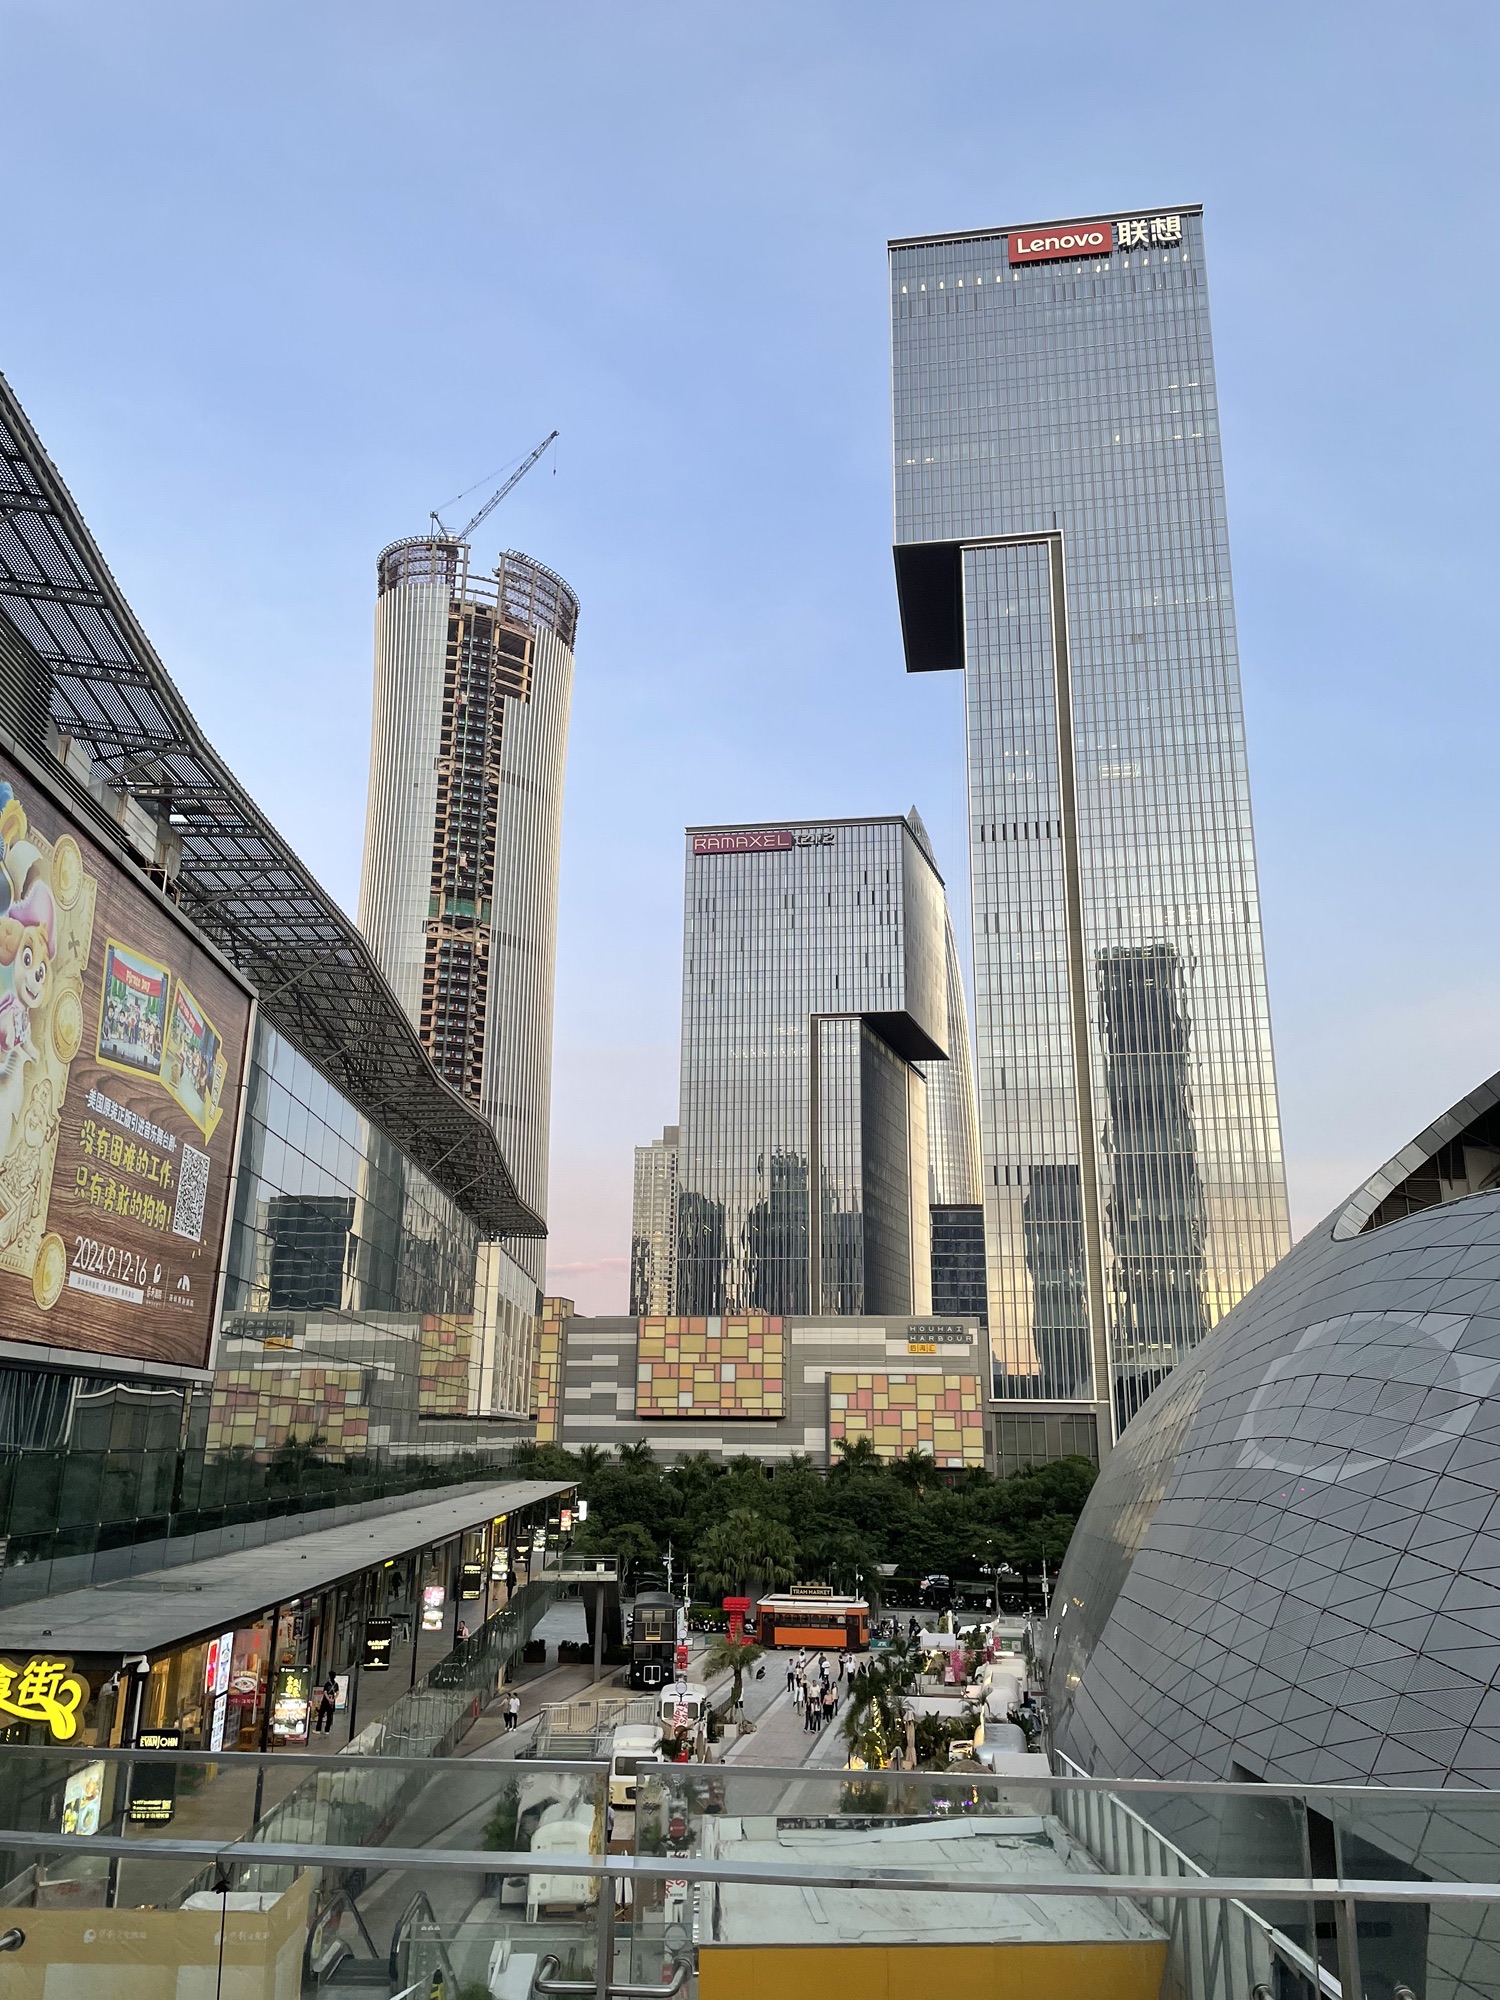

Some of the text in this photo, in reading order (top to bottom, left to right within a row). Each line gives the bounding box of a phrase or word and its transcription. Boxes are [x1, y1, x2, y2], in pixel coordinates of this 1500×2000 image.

[1017, 232, 1104, 254] Lenovo
[1116, 215, 1182, 246] 联想
[694, 834, 790, 851] RAMAXEL
[72, 1235, 148, 1286] 2024.9.12-16
